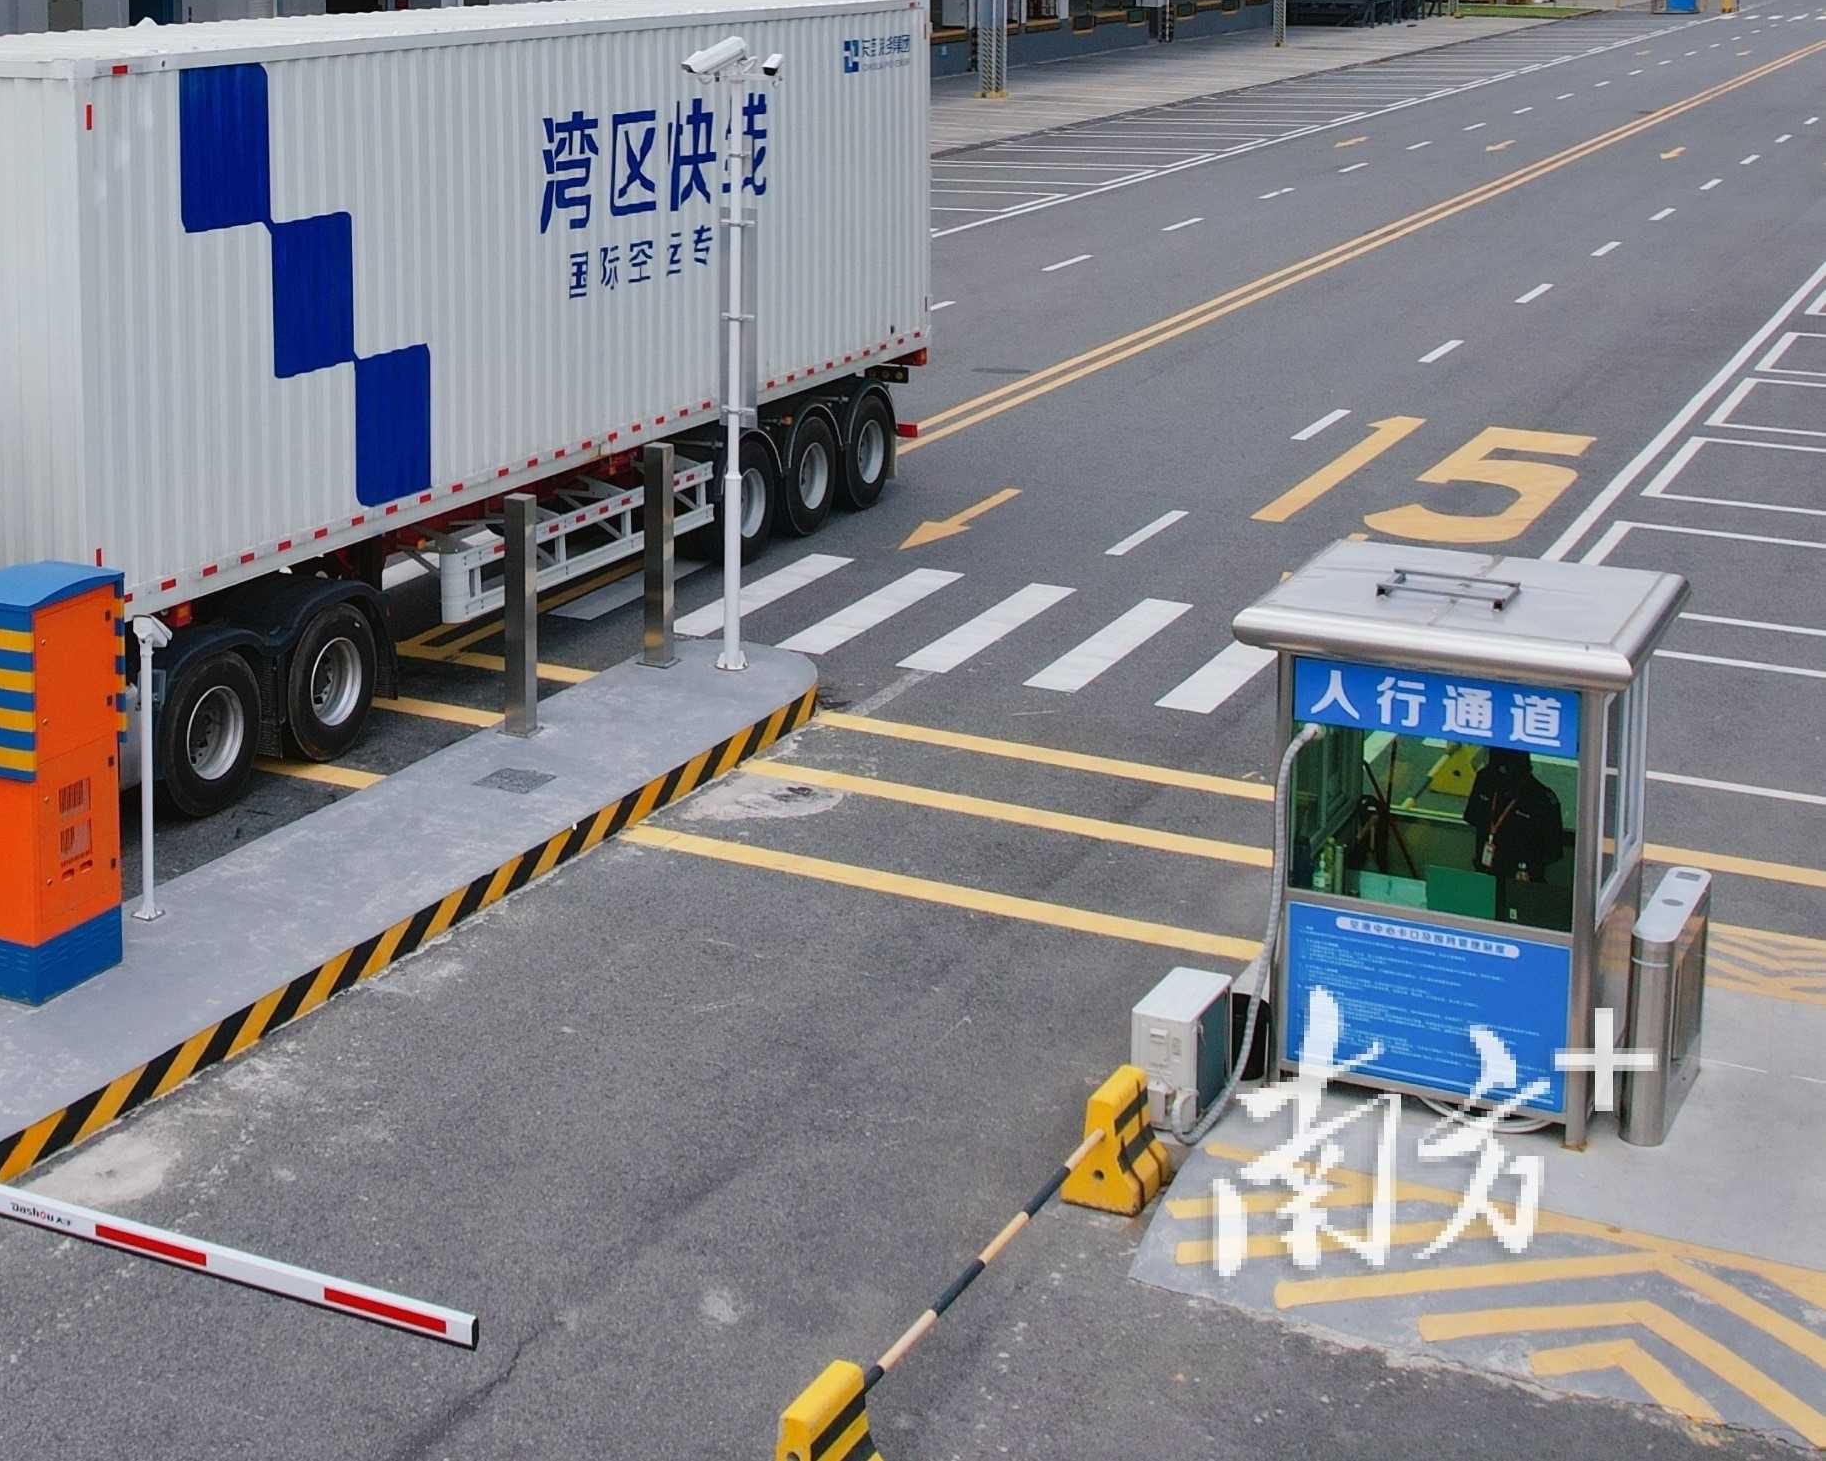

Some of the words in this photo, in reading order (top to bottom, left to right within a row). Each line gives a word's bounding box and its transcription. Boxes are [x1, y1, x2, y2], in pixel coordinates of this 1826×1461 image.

[569, 225, 713, 300] 国际空运专
[1250, 416, 1598, 544] 15
[1310, 670, 1563, 748] 人行通道
